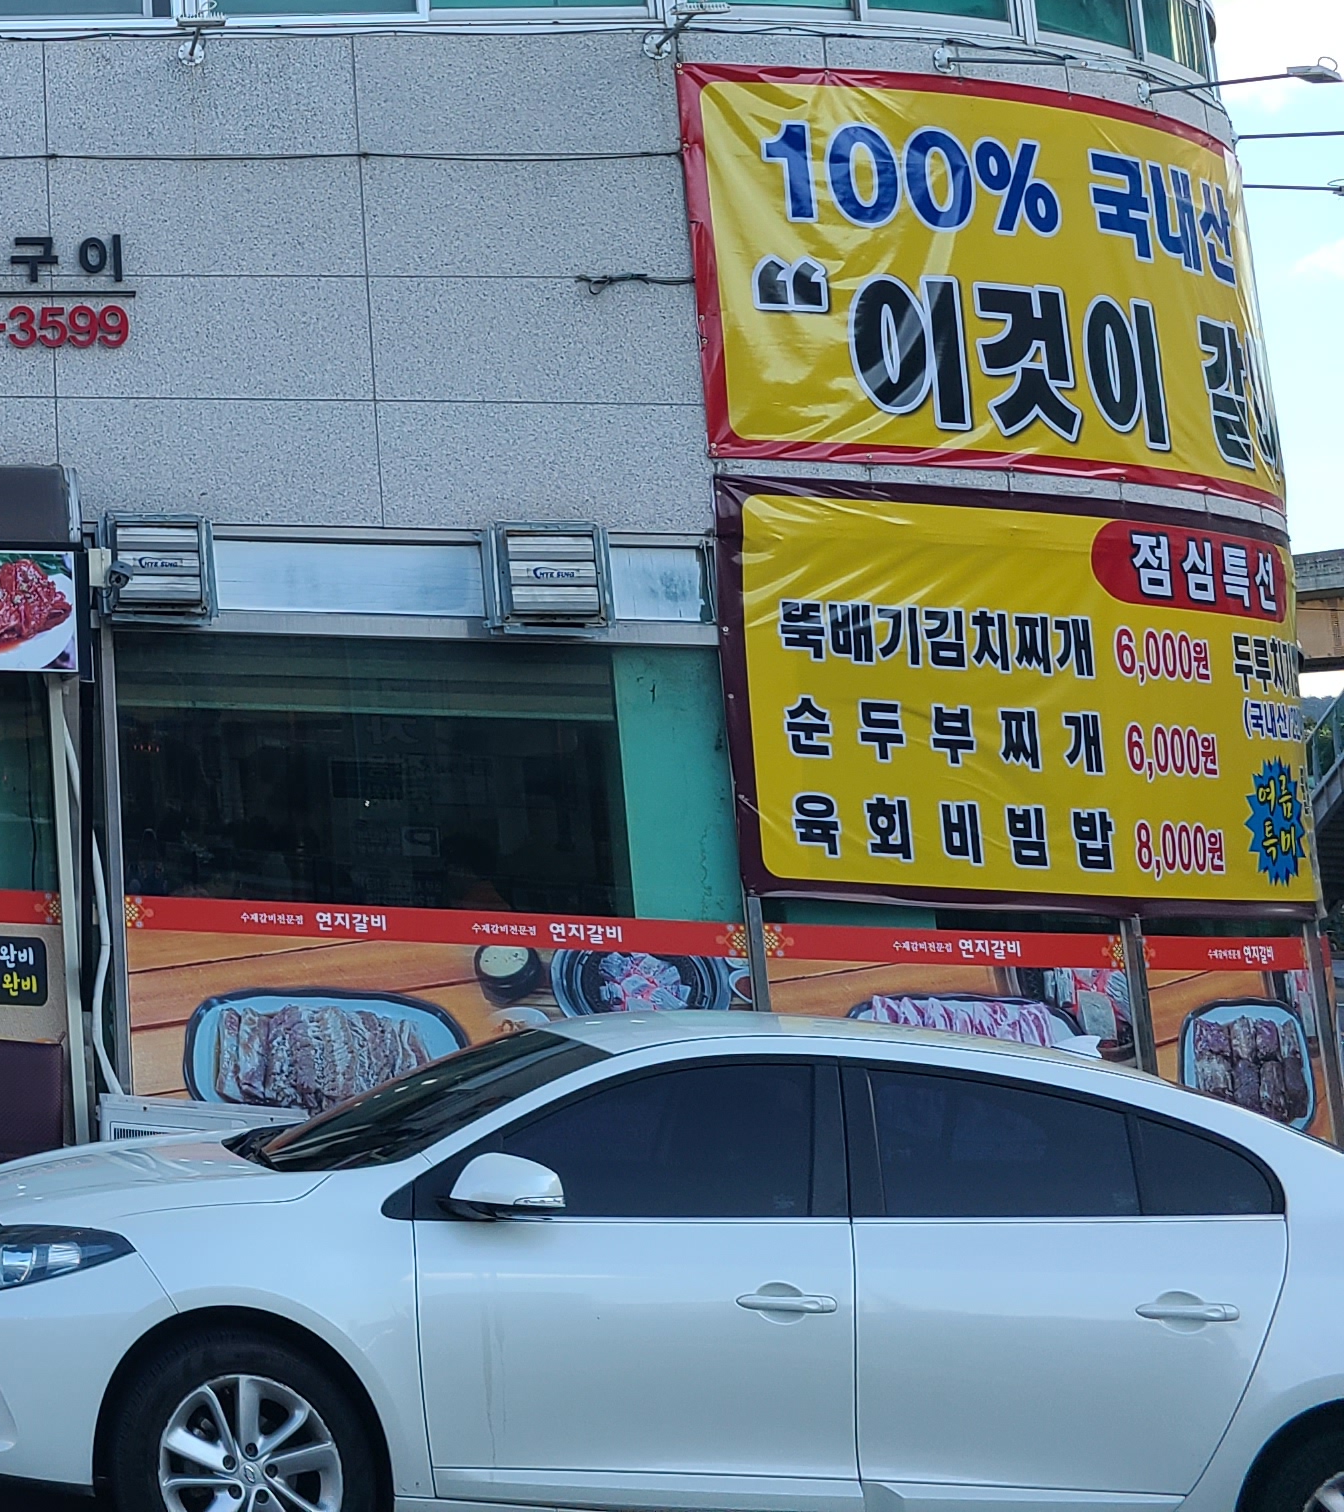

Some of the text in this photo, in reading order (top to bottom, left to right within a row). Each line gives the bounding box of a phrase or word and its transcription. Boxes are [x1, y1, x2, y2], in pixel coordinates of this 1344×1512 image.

[761, 119, 1238, 288] 100% 국내산
[1129, 529, 1278, 613] 점심특선
[777, 598, 1097, 680] 뚝배기김치찌개
[1114, 624, 1213, 686] 6,000원
[783, 694, 1220, 782] 순두부찌개 6,000원
[792, 790, 1227, 881] 육회비빔밥 8,000원
[240, 909, 388, 933] 수제갈비전문점 연지갈비
[471, 921, 624, 945] 수제갈비전문점 연지갈비
[0, 943, 35, 968] 완비
[892, 937, 1023, 960] 수제갈비전문점 연지갈비
[1243, 945, 1275, 965] 연지갈비
[2, 972, 38, 994] 완비
